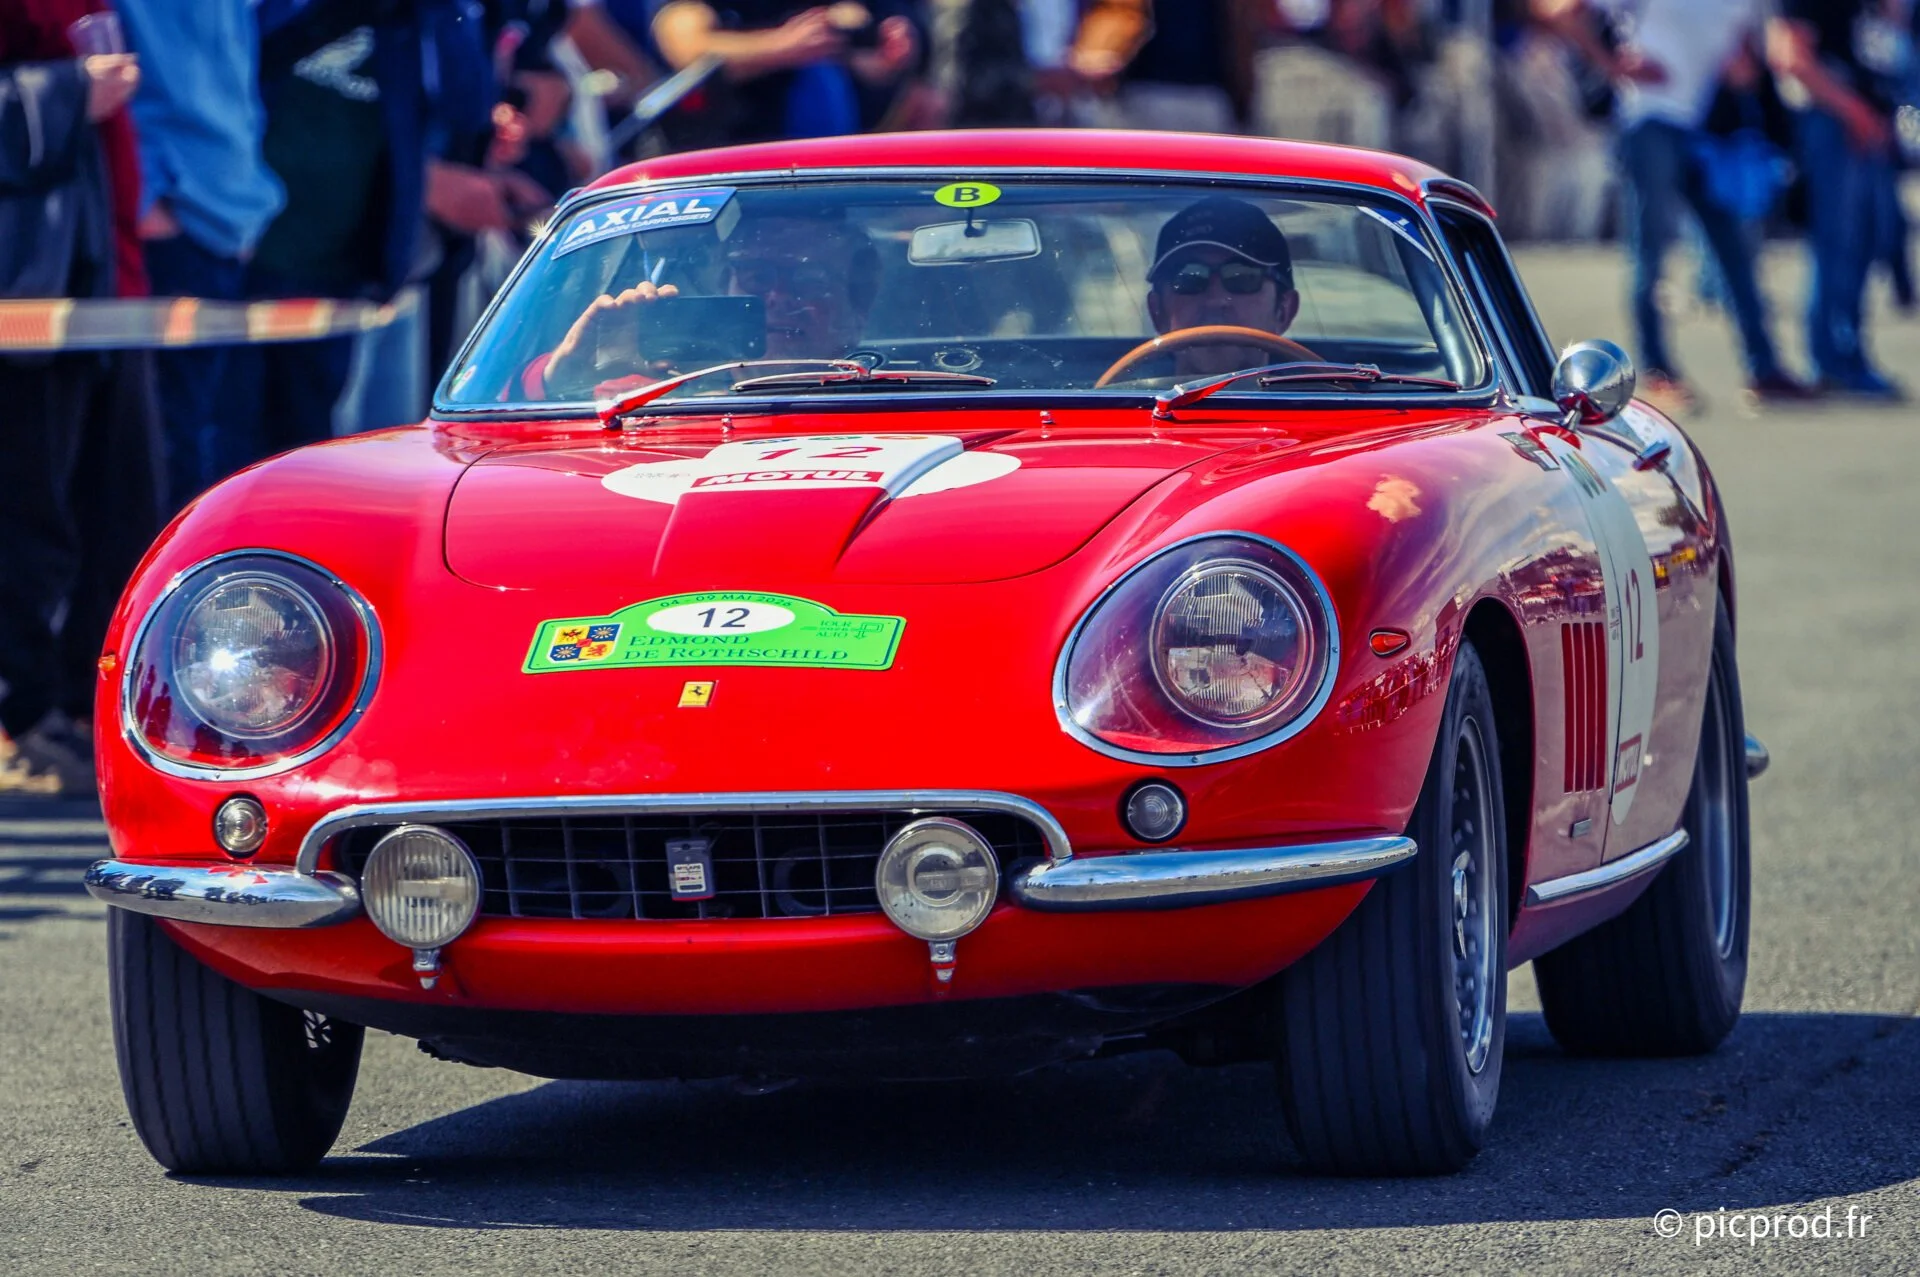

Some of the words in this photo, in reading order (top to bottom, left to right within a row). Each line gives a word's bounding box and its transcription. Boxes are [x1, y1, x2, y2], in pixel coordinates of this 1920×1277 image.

[953, 187, 981, 203] B
[564, 199, 713, 245] AXIAL
[758, 446, 884, 461] 12
[700, 470, 873, 486] MOTUL
[695, 594, 716, 602] 09
[697, 607, 750, 629] 12
[1625, 568, 1644, 664] 12
[629, 635, 750, 646] EDMOND
[624, 650, 659, 660] DE
[669, 648, 848, 660] ROTHSCHILD
